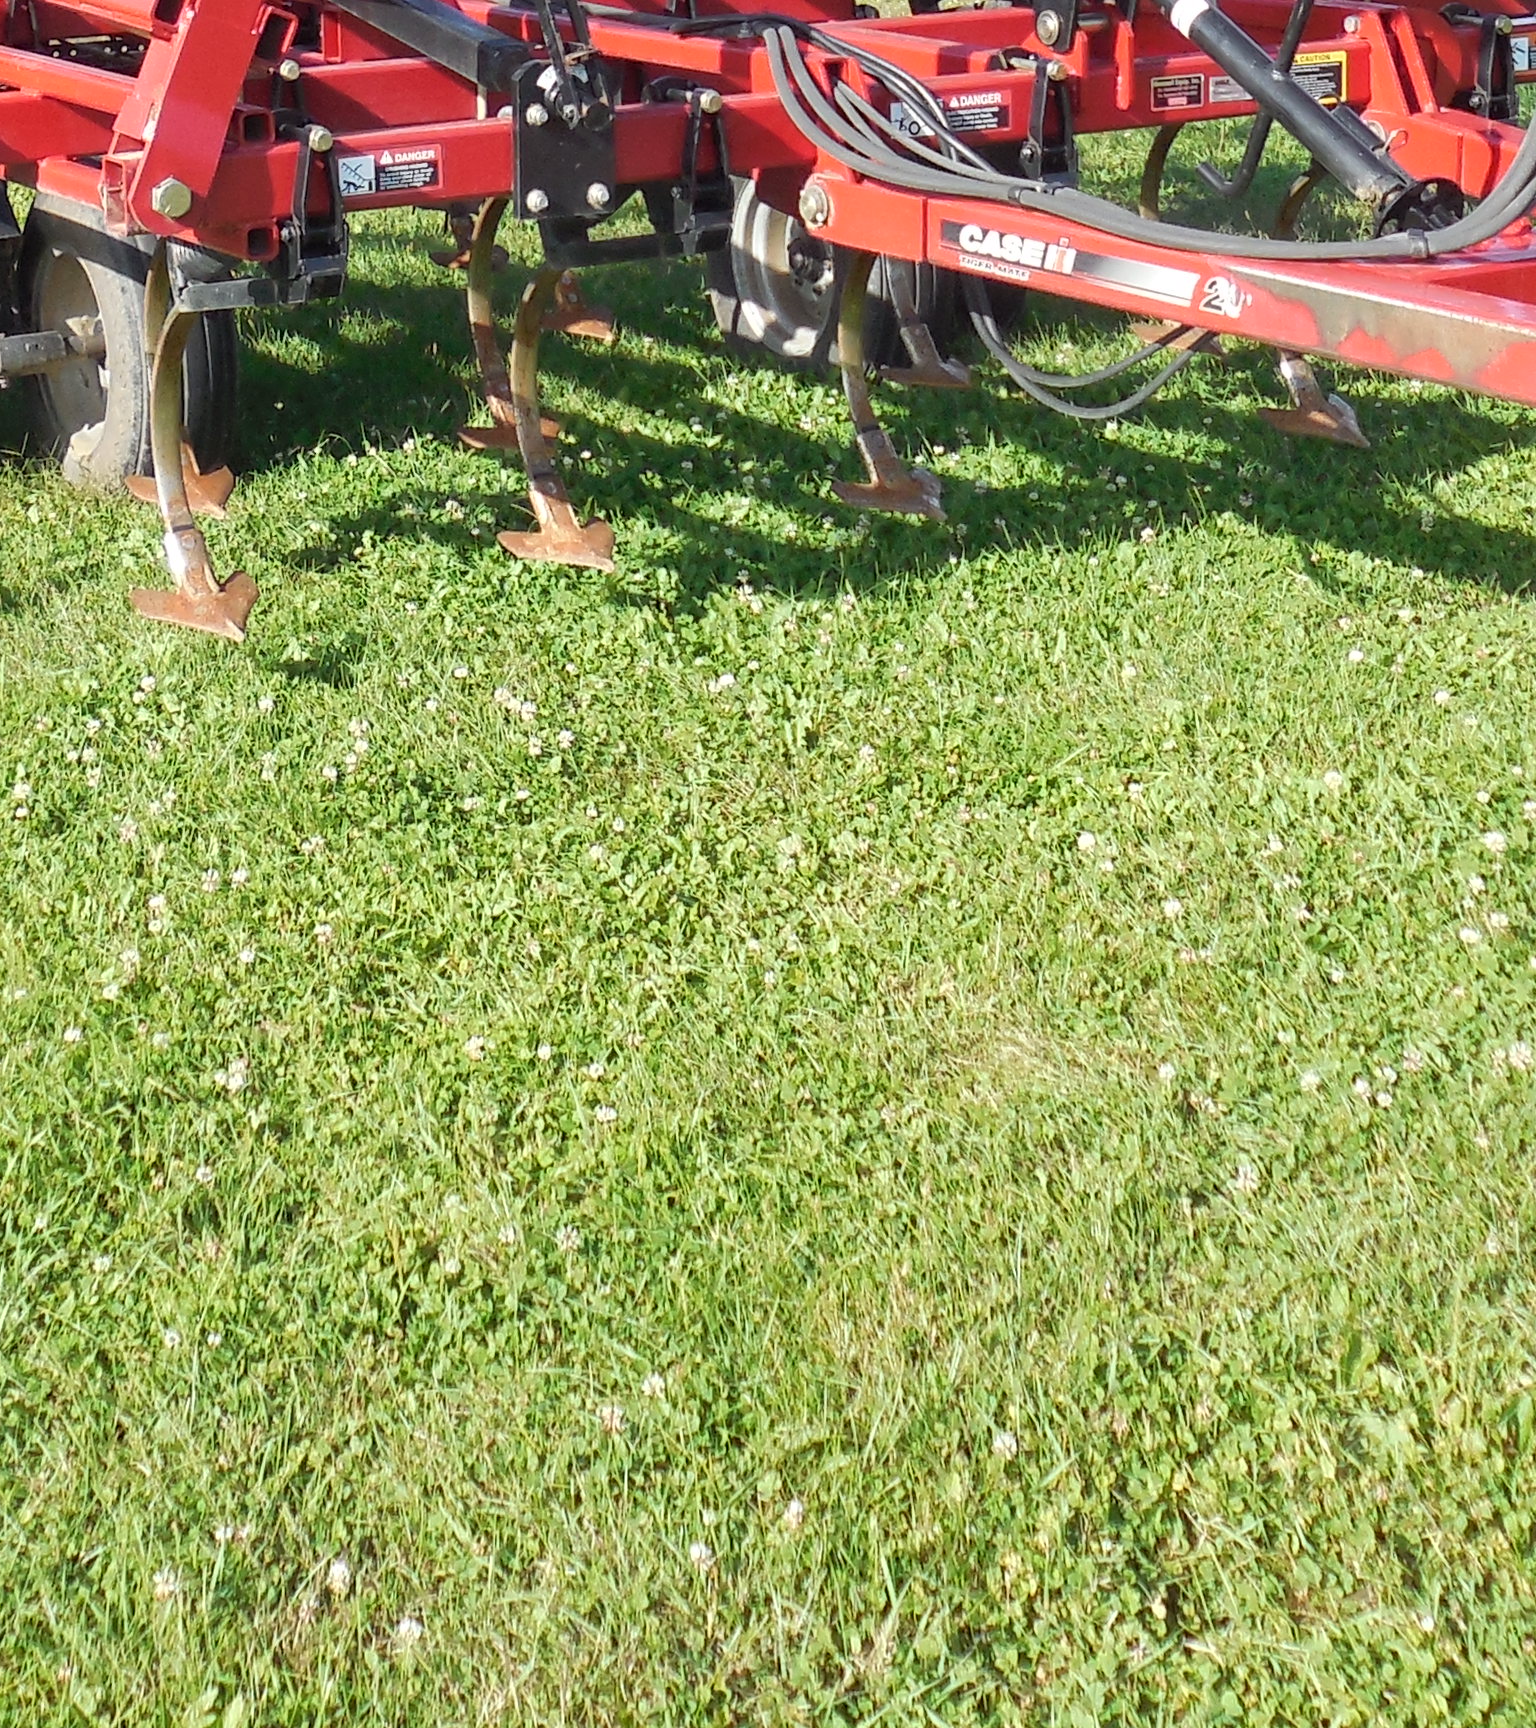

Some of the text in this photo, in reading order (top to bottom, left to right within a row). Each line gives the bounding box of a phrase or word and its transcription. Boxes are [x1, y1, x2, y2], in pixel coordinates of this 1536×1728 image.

[1299, 54, 1331, 63] CAUTION
[960, 92, 1002, 107] DANGER
[394, 149, 436, 163] DANGER
[959, 224, 1046, 270] CASE
